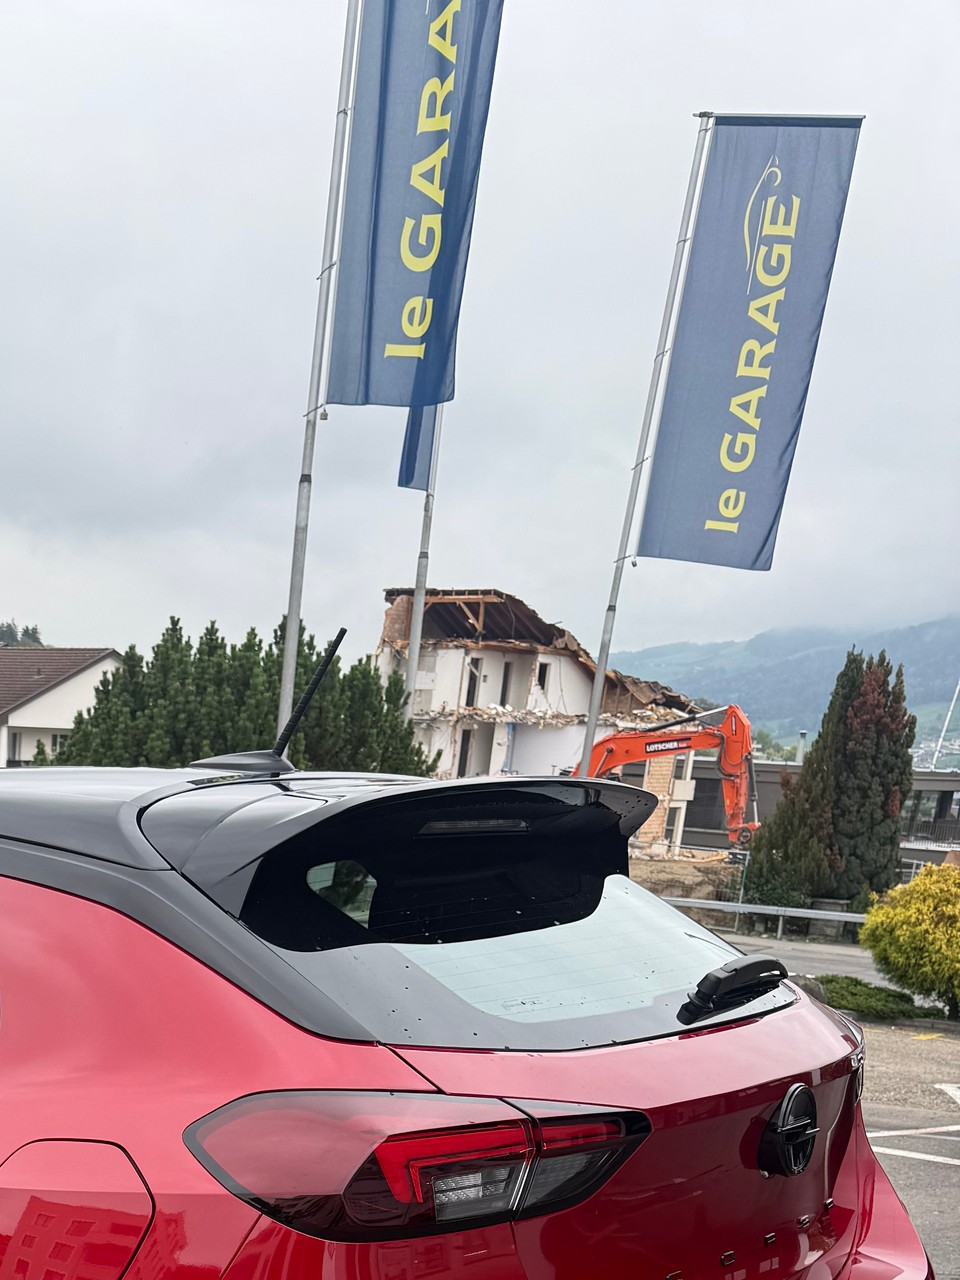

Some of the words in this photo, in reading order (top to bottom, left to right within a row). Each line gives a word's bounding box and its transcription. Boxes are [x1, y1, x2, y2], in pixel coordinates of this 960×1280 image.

[400, 0, 462, 273] GARA
[384, 296, 434, 360] le
[719, 195, 801, 473] GARAGE
[704, 488, 746, 534] le
